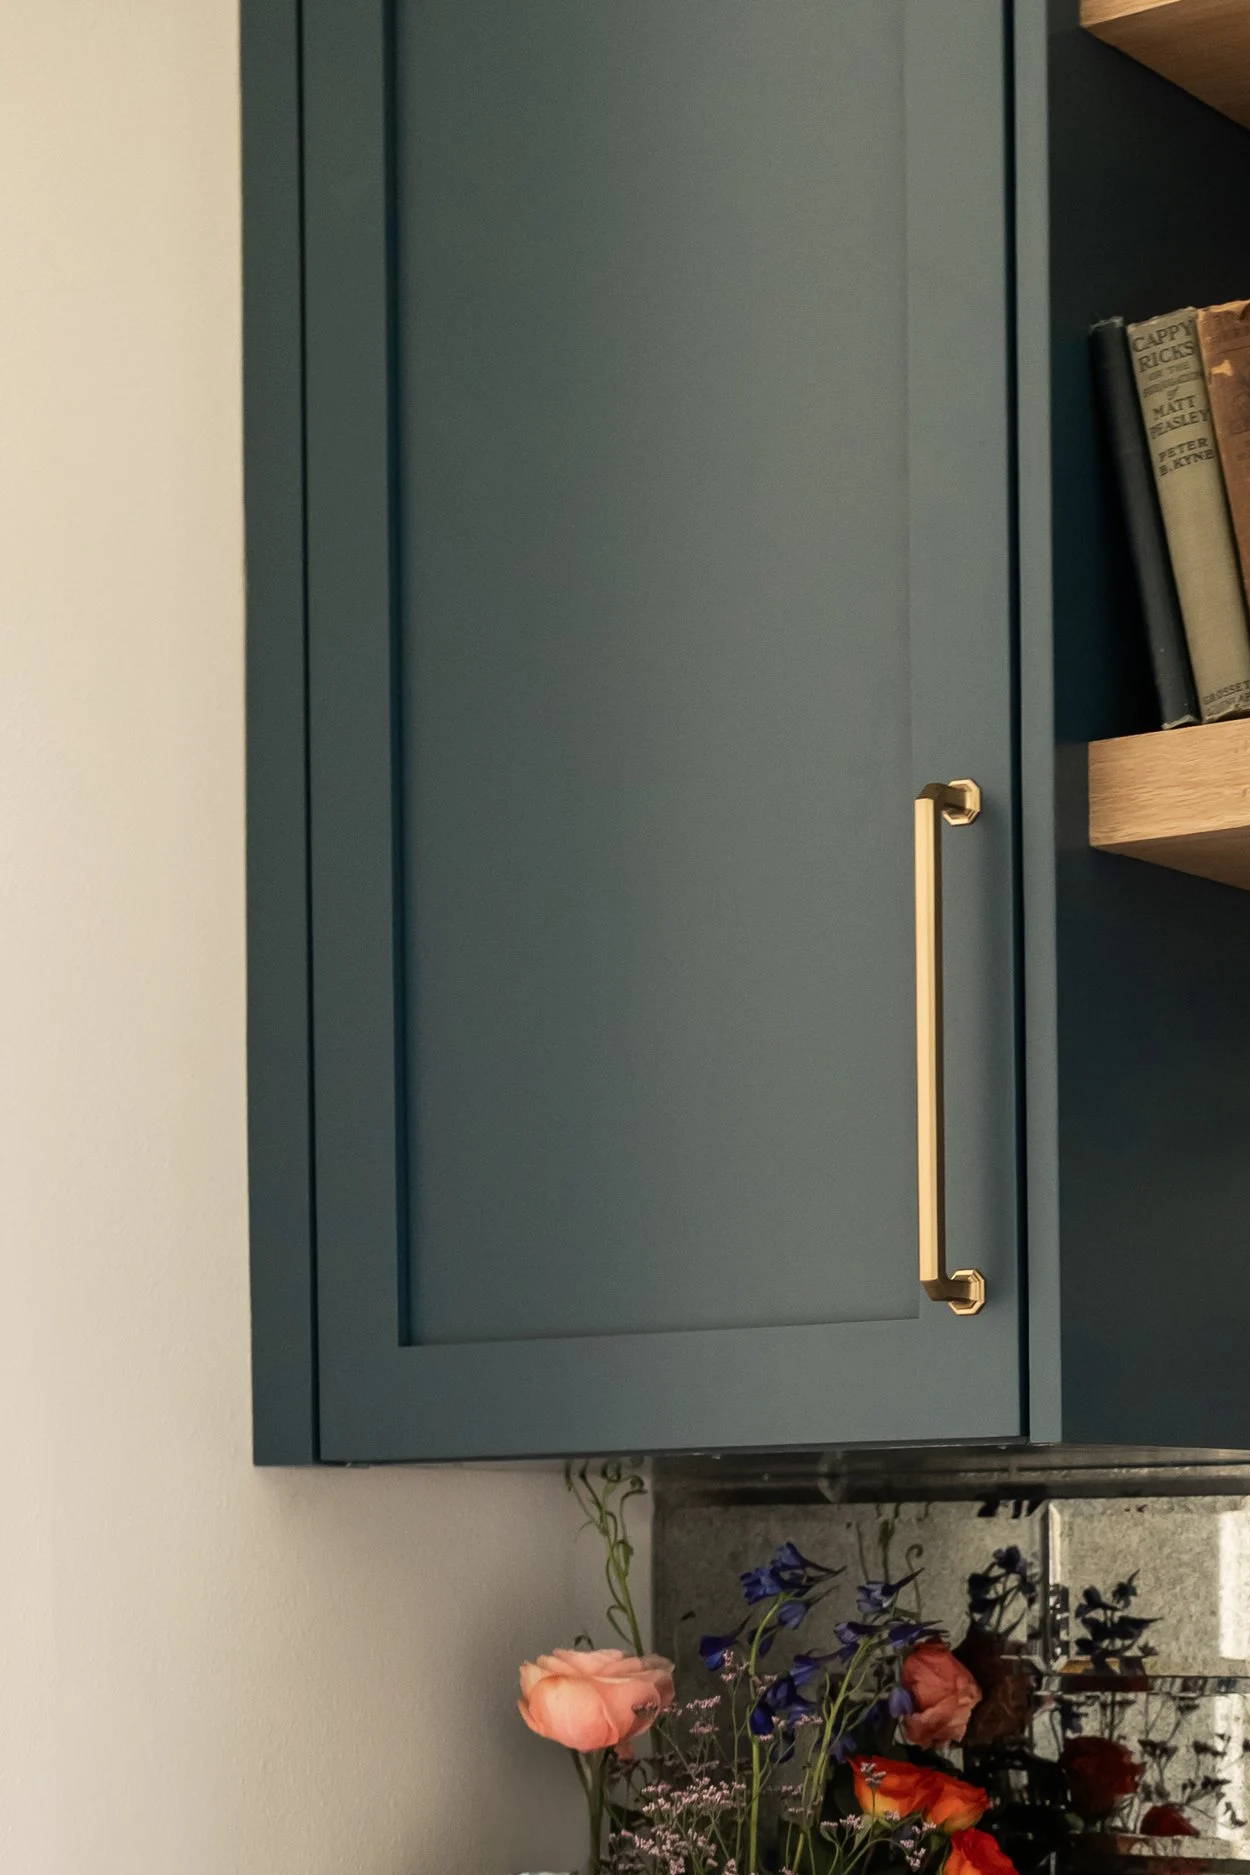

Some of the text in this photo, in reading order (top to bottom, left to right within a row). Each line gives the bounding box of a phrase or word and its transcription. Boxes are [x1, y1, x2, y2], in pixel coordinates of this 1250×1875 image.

[1132, 319, 1194, 353] CAPPY
[1137, 340, 1196, 374] RICKS
[1152, 395, 1196, 421] MATT
[1157, 437, 1209, 463] PETER
